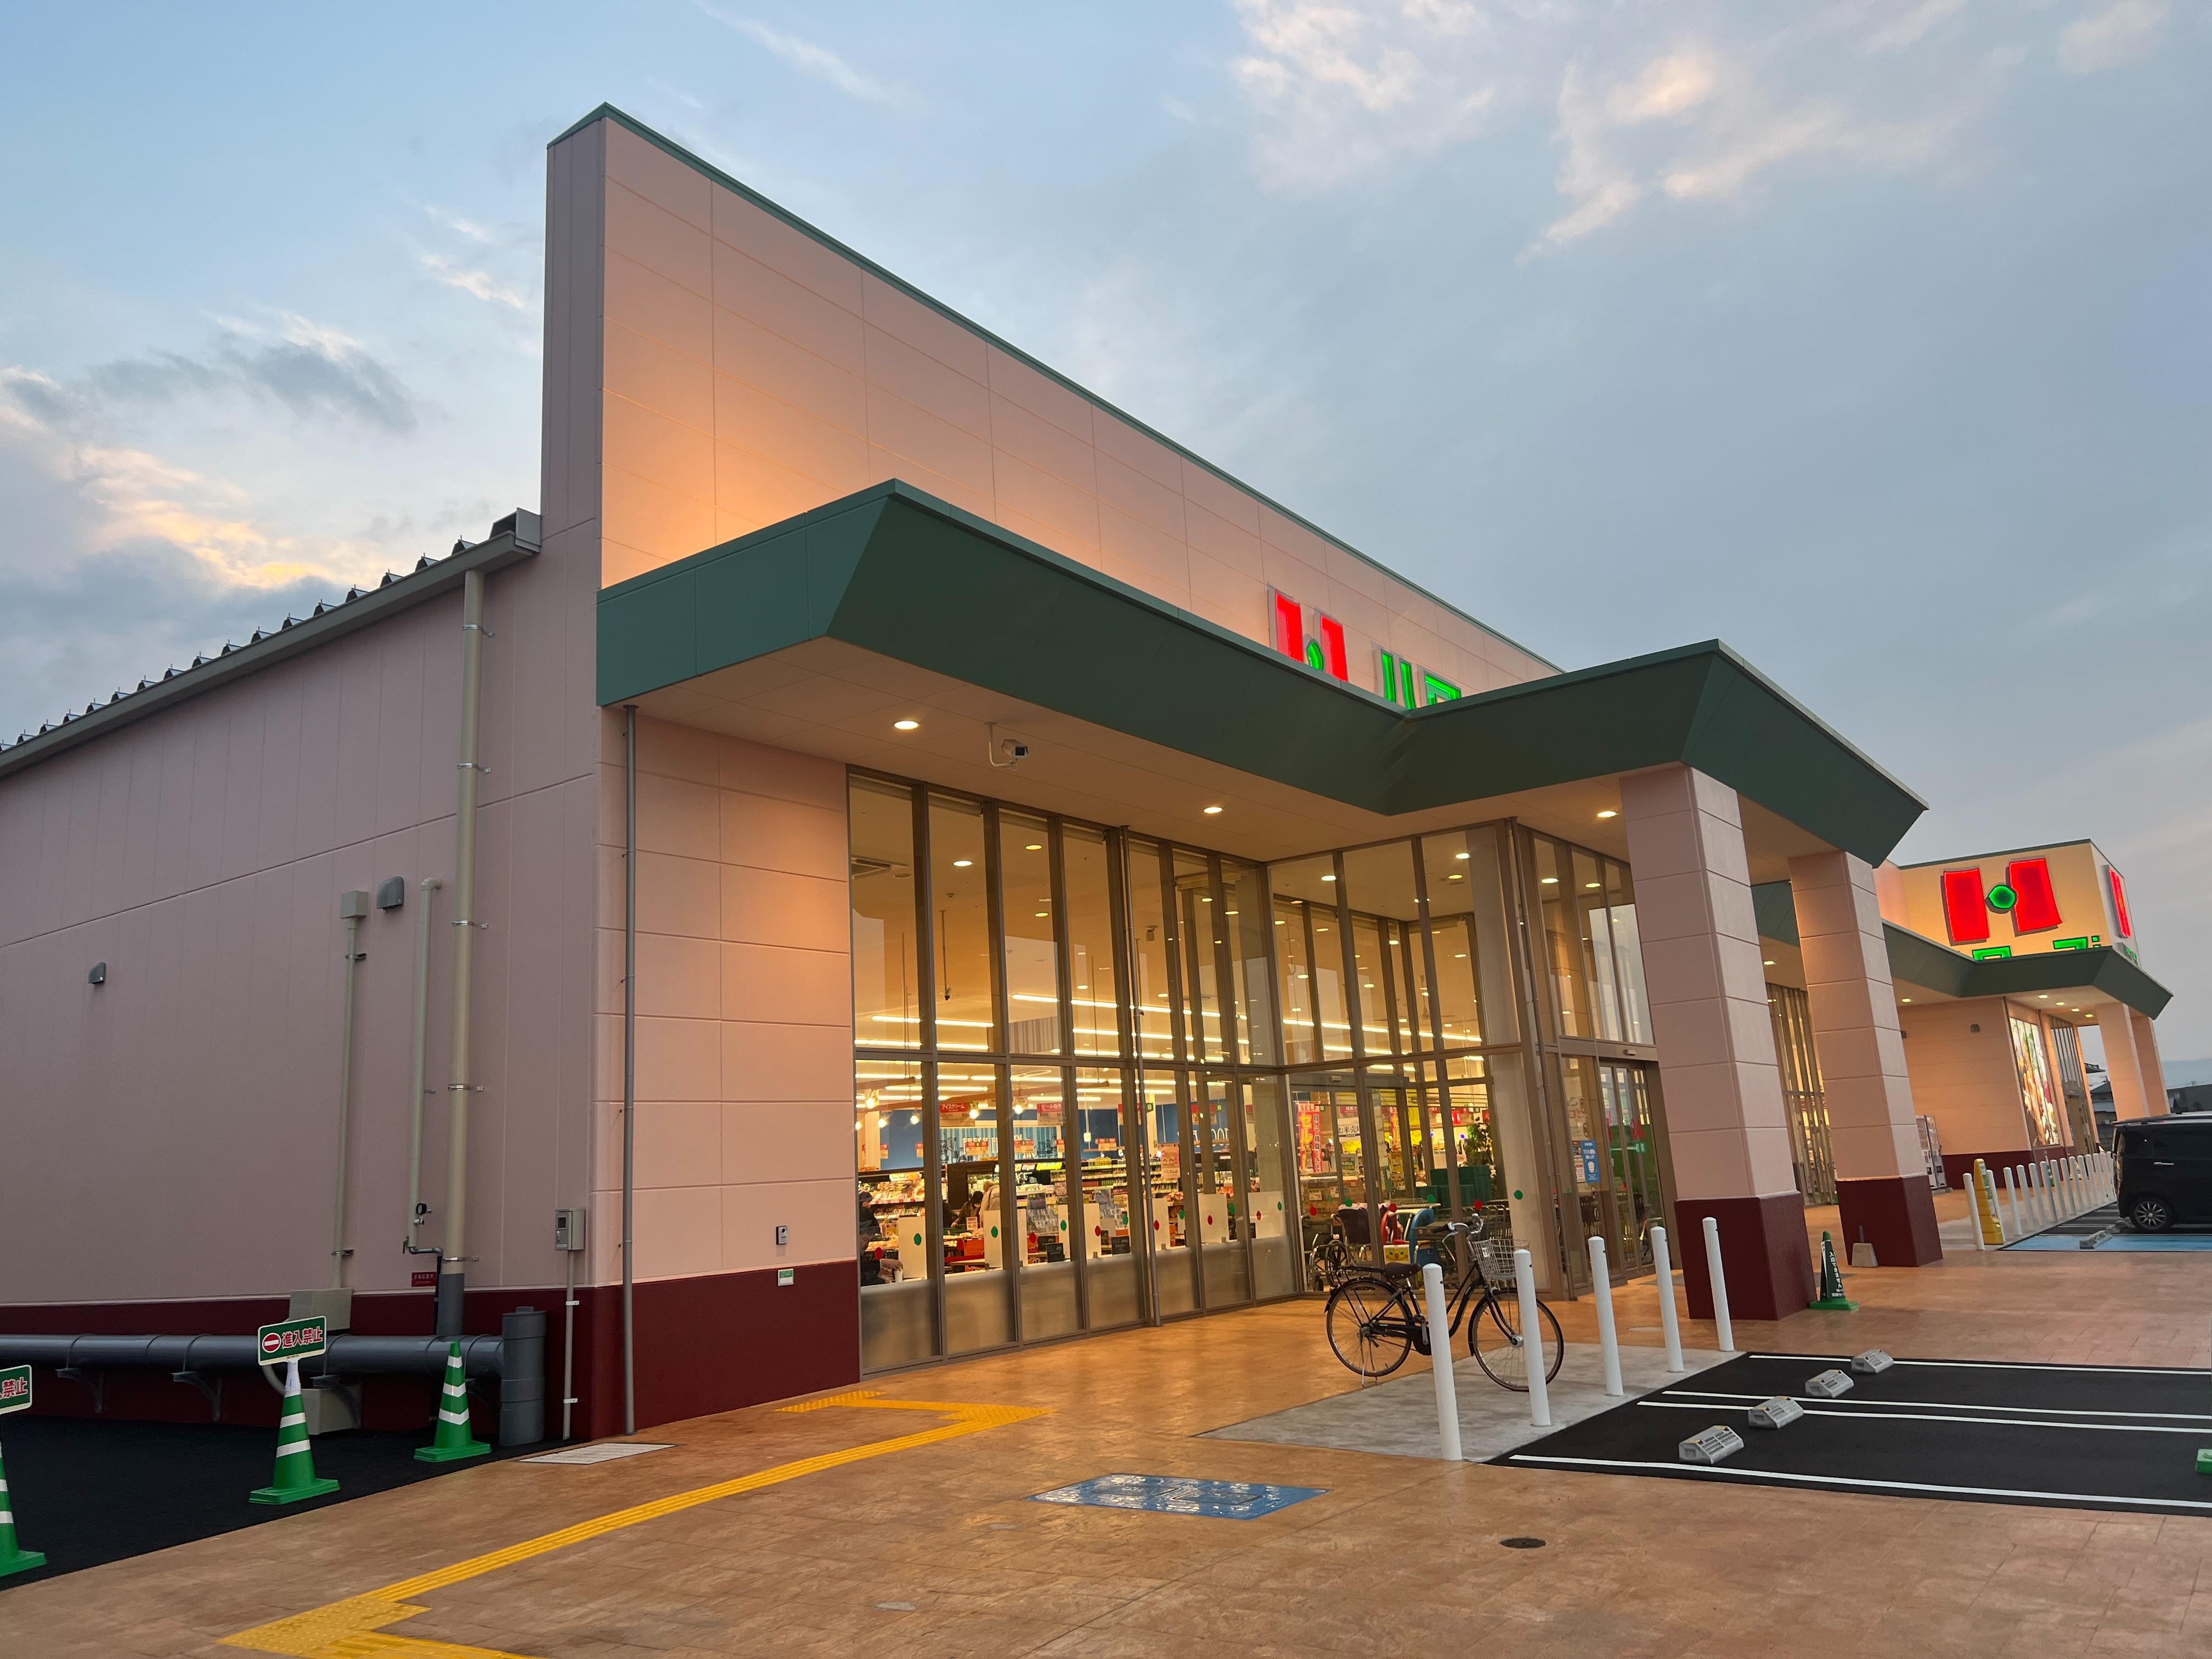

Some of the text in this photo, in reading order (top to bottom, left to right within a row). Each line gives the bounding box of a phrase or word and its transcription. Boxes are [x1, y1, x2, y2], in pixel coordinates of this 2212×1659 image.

[282, 1325, 324, 1349] 進入禁止
[0, 1376, 28, 1400] 禁止
